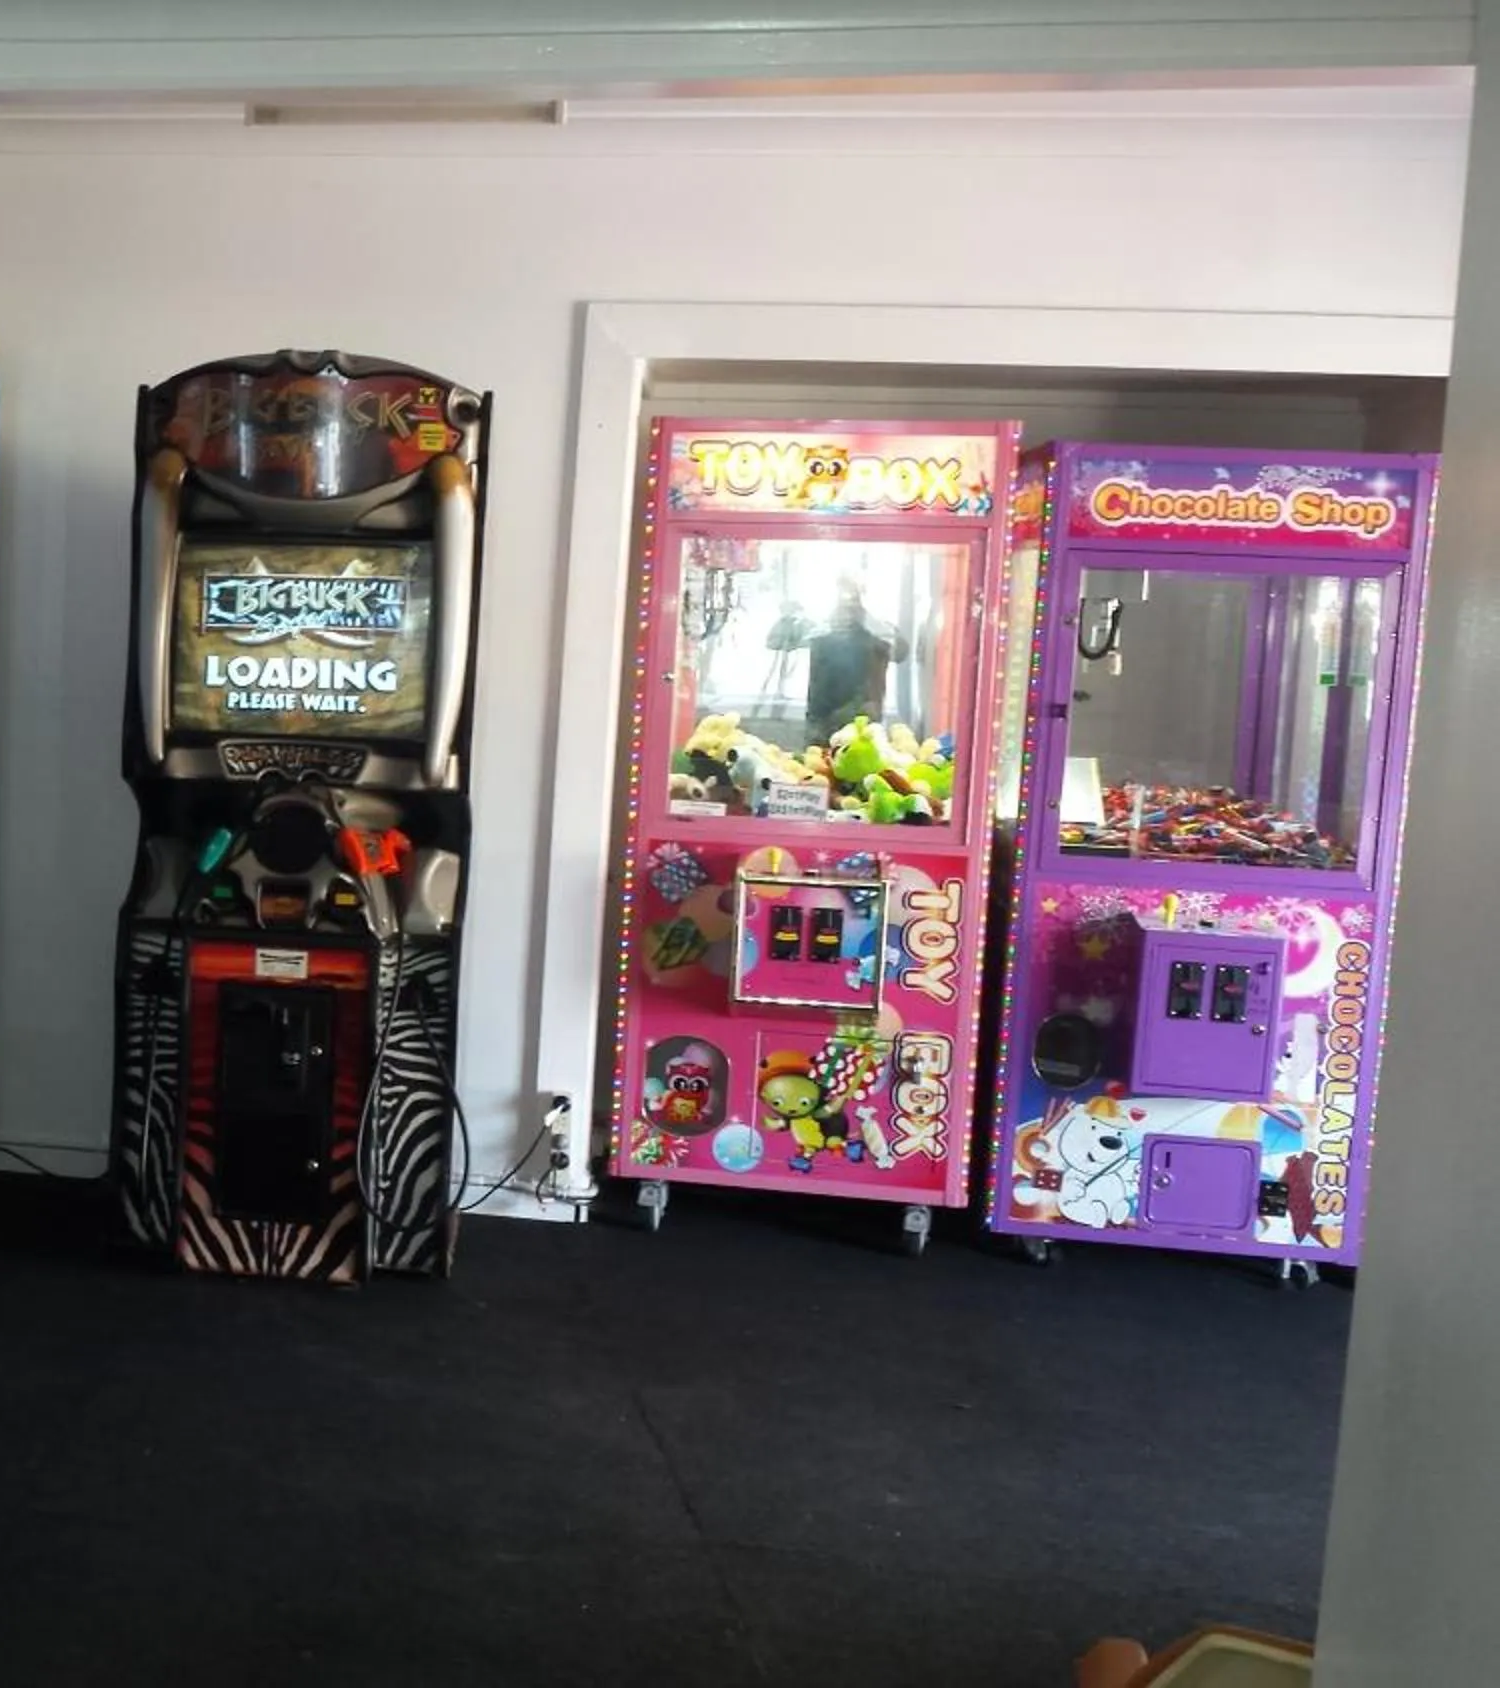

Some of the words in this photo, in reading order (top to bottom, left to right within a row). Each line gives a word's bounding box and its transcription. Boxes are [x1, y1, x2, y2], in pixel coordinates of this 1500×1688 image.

[690, 440, 803, 497] TOY
[844, 457, 962, 511] BOX
[1094, 481, 1282, 523] Chocolate
[1291, 491, 1391, 535] Shop
[204, 655, 397, 692] LOADING
[227, 691, 296, 711] PLEASE
[301, 693, 367, 714] WAIT.
[902, 877, 964, 1004] TOY
[889, 1031, 955, 1159] BOX
[1312, 940, 1371, 1217] CHOCOLATES
